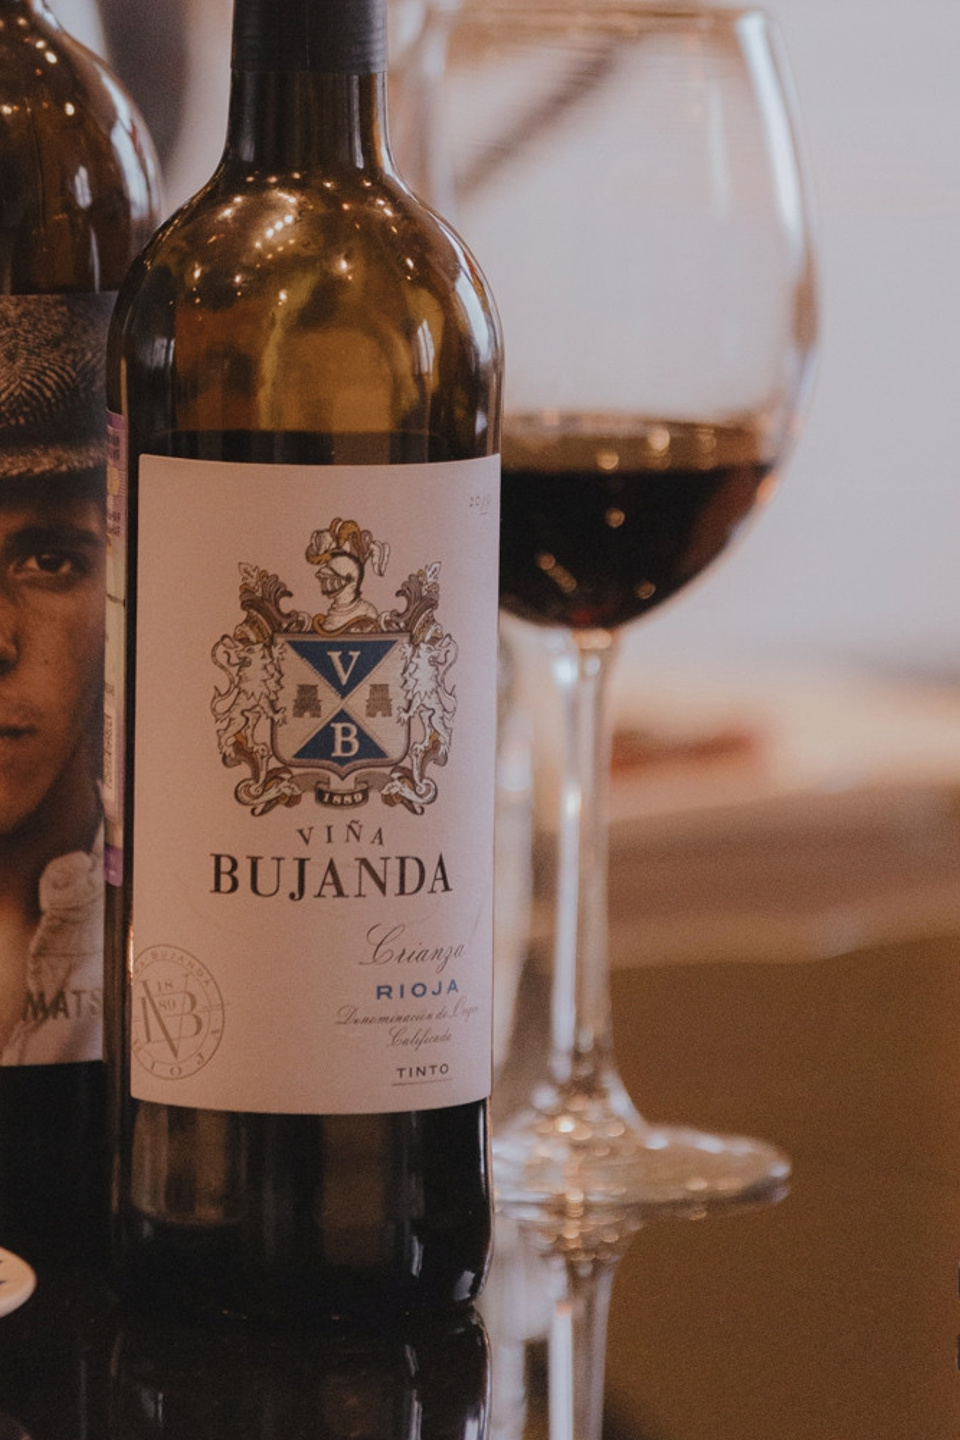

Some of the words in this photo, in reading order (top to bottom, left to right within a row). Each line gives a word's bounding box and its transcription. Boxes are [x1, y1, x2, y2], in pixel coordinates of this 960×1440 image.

[326, 650, 361, 686] V
[330, 722, 360, 757] B
[323, 791, 364, 805] 1889
[296, 820, 384, 847] VIÑA
[209, 852, 453, 902] BUJANDA
[358, 922, 466, 975] Crianza
[376, 978, 459, 1000] RIOJA
[396, 1062, 450, 1078] TINTO
